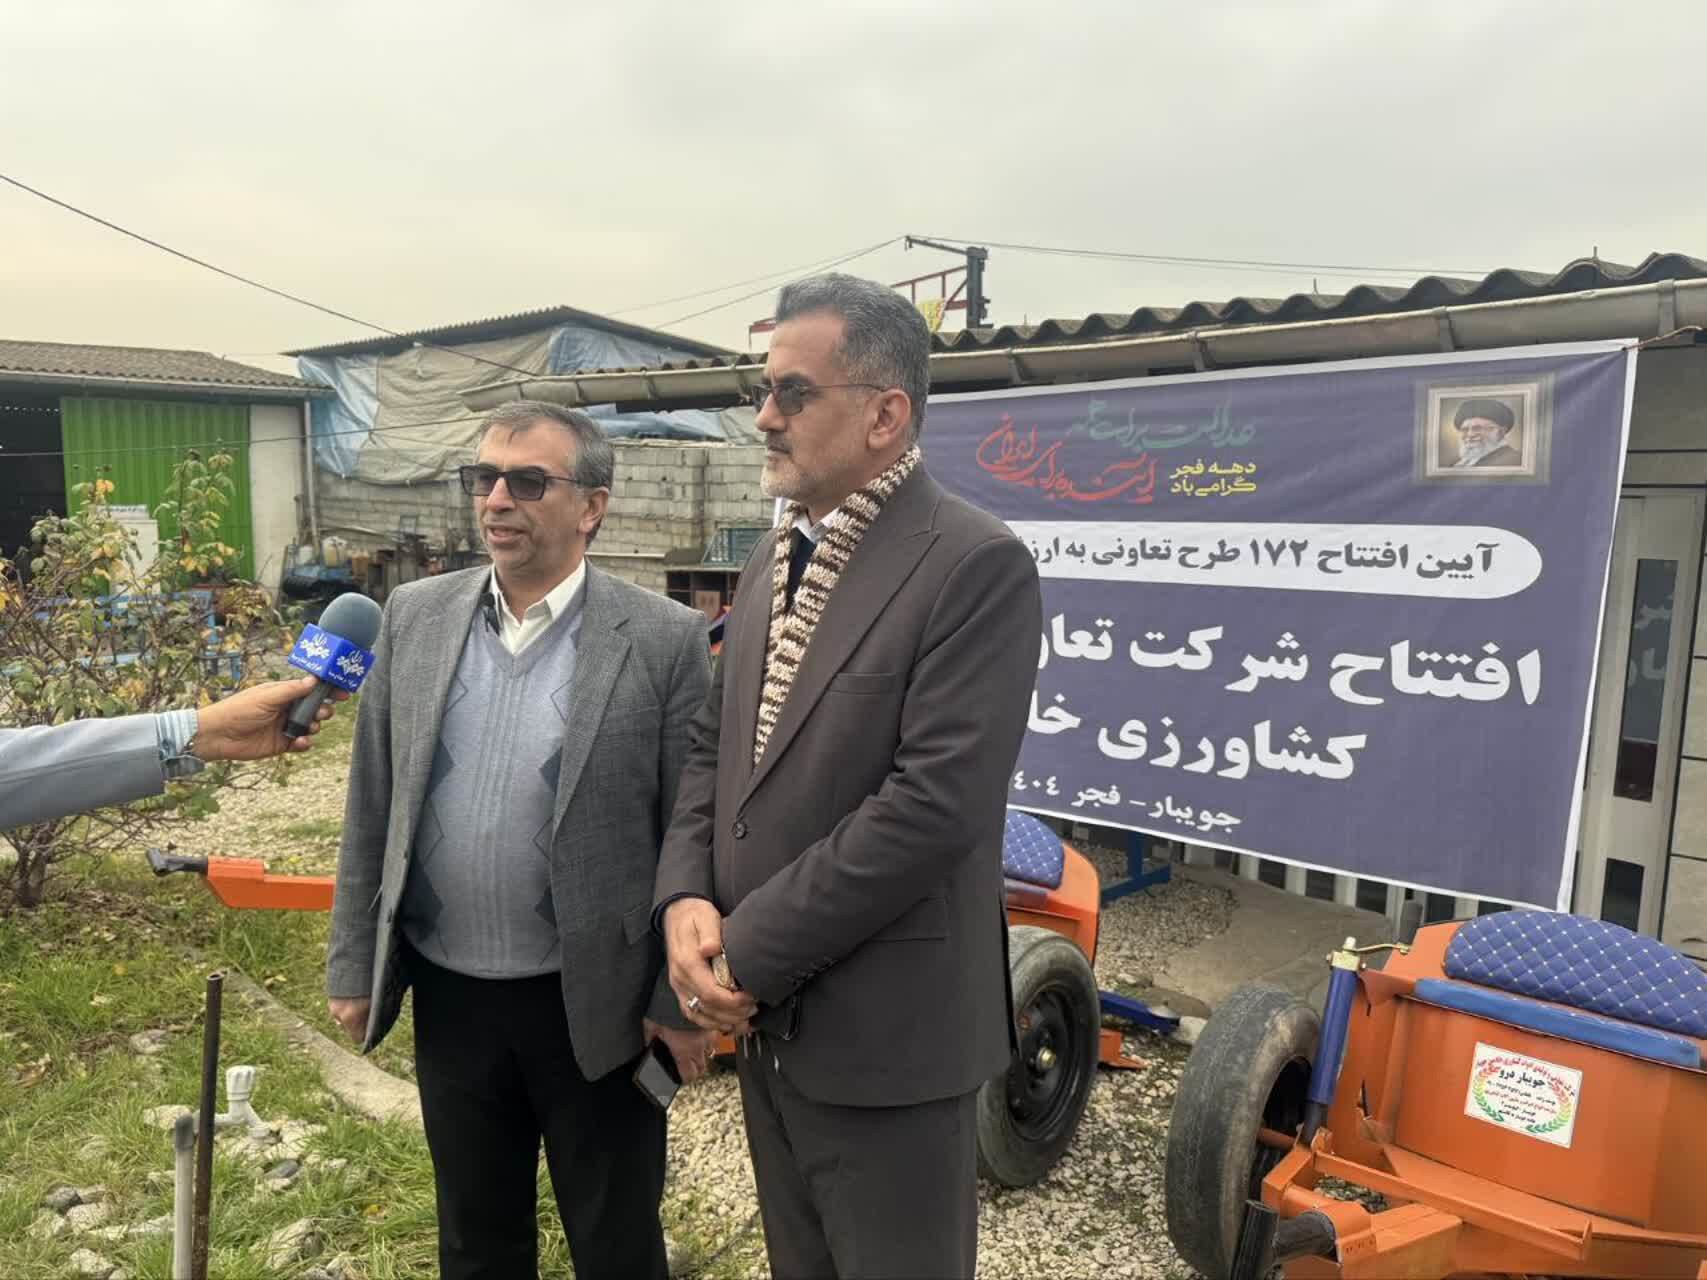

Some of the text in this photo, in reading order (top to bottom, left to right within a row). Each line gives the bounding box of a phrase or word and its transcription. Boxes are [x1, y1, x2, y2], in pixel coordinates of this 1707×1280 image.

[1169, 458, 1257, 479] دهه فجر
[1018, 536, 1060, 563] ارز
[1065, 541, 1086, 563] به
[1091, 537, 1172, 566] تعاونی
[1178, 539, 1241, 570] طرح
[1317, 541, 1409, 574] افتتاح
[1415, 542, 1500, 579] آیین
[1129, 625, 1309, 692] شرکت
[1329, 639, 1541, 705] افتتاح
[1027, 690, 1367, 780] کشاورزی خا
[1071, 785, 1121, 808] فجر
